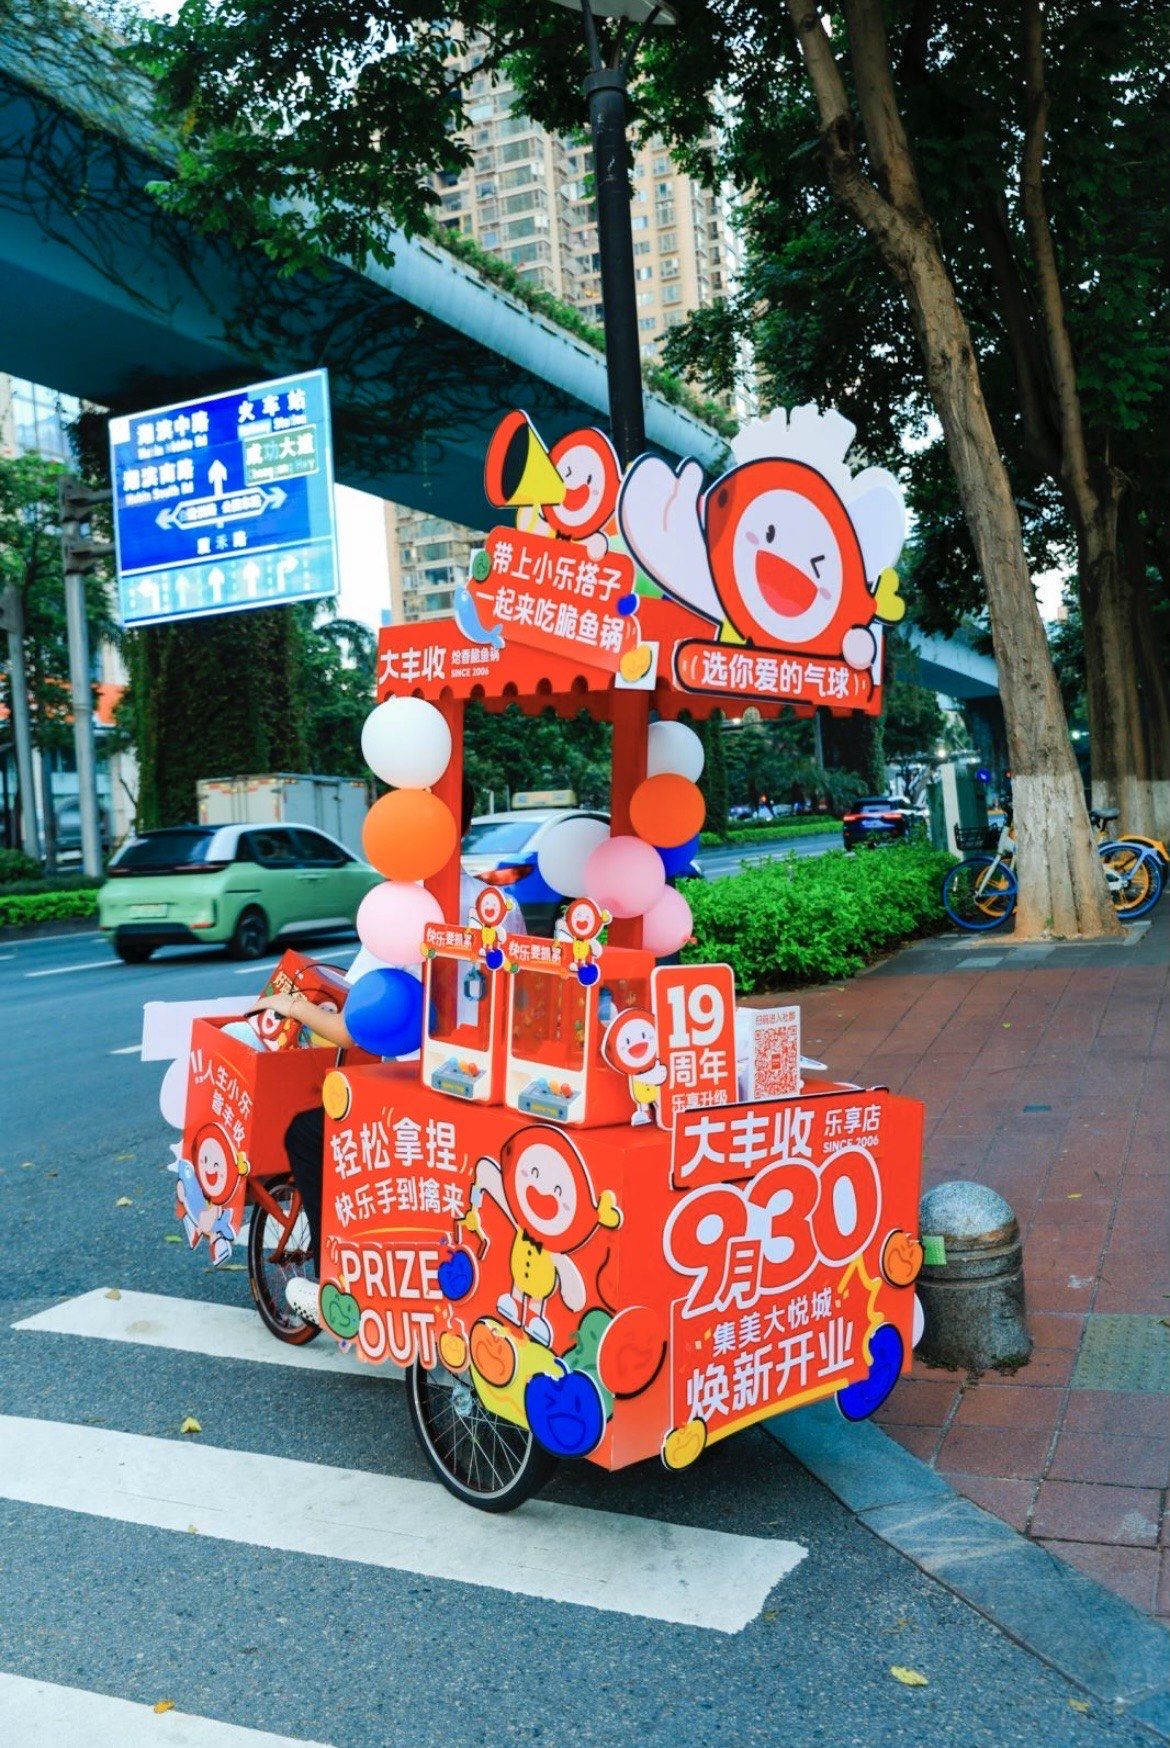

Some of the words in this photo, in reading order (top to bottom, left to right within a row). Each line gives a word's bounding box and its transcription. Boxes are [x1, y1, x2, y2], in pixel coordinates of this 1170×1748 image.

[492, 541, 622, 602] 带上小乐搭子
[475, 586, 625, 654] 一起来吃脆鱼锅
[378, 645, 447, 685] 大丰收
[450, 668, 471, 678] SINCE
[472, 667, 490, 677] 2006
[701, 650, 850, 700] 选你爱的气球
[667, 983, 725, 1049] 19
[668, 1047, 728, 1090] 周年
[680, 1106, 816, 1178] 大丰收
[822, 1138, 852, 1154] SINCE
[853, 1135, 879, 1150] 2006
[823, 1104, 882, 1138] 乐享店
[330, 1117, 457, 1180] 轻松拿捏
[335, 1175, 465, 1228] 快乐手到擒来
[340, 1250, 443, 1300] PRIZE
[358, 1308, 436, 1363] OUT
[712, 1286, 833, 1358] 集美大悦城
[686, 1316, 855, 1425] 焕新开业
